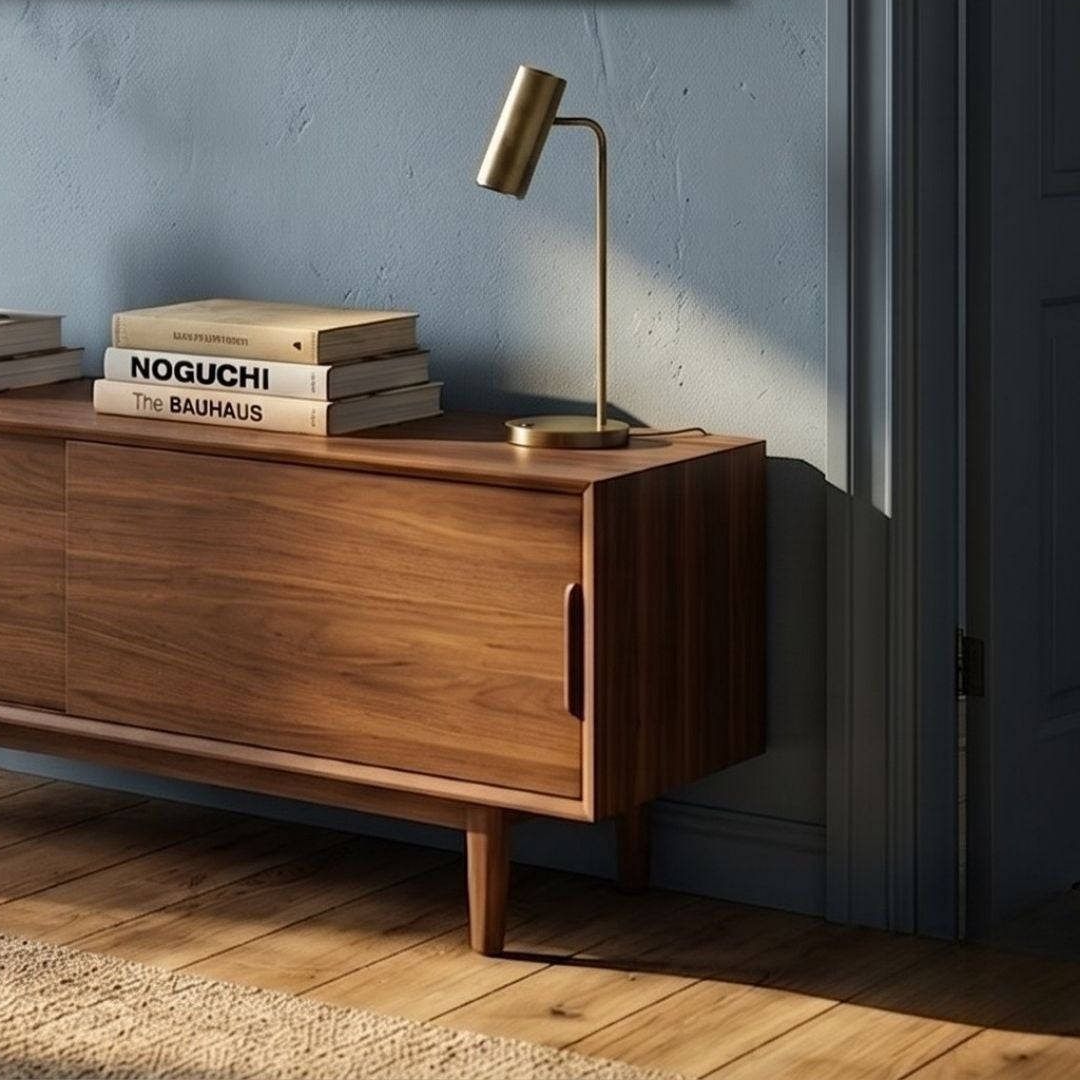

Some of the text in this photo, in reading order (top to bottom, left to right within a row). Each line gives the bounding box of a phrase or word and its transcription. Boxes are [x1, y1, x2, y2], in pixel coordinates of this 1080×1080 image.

[131, 356, 269, 390] NOGUCHI
[132, 392, 263, 422] The BAUHAUS
